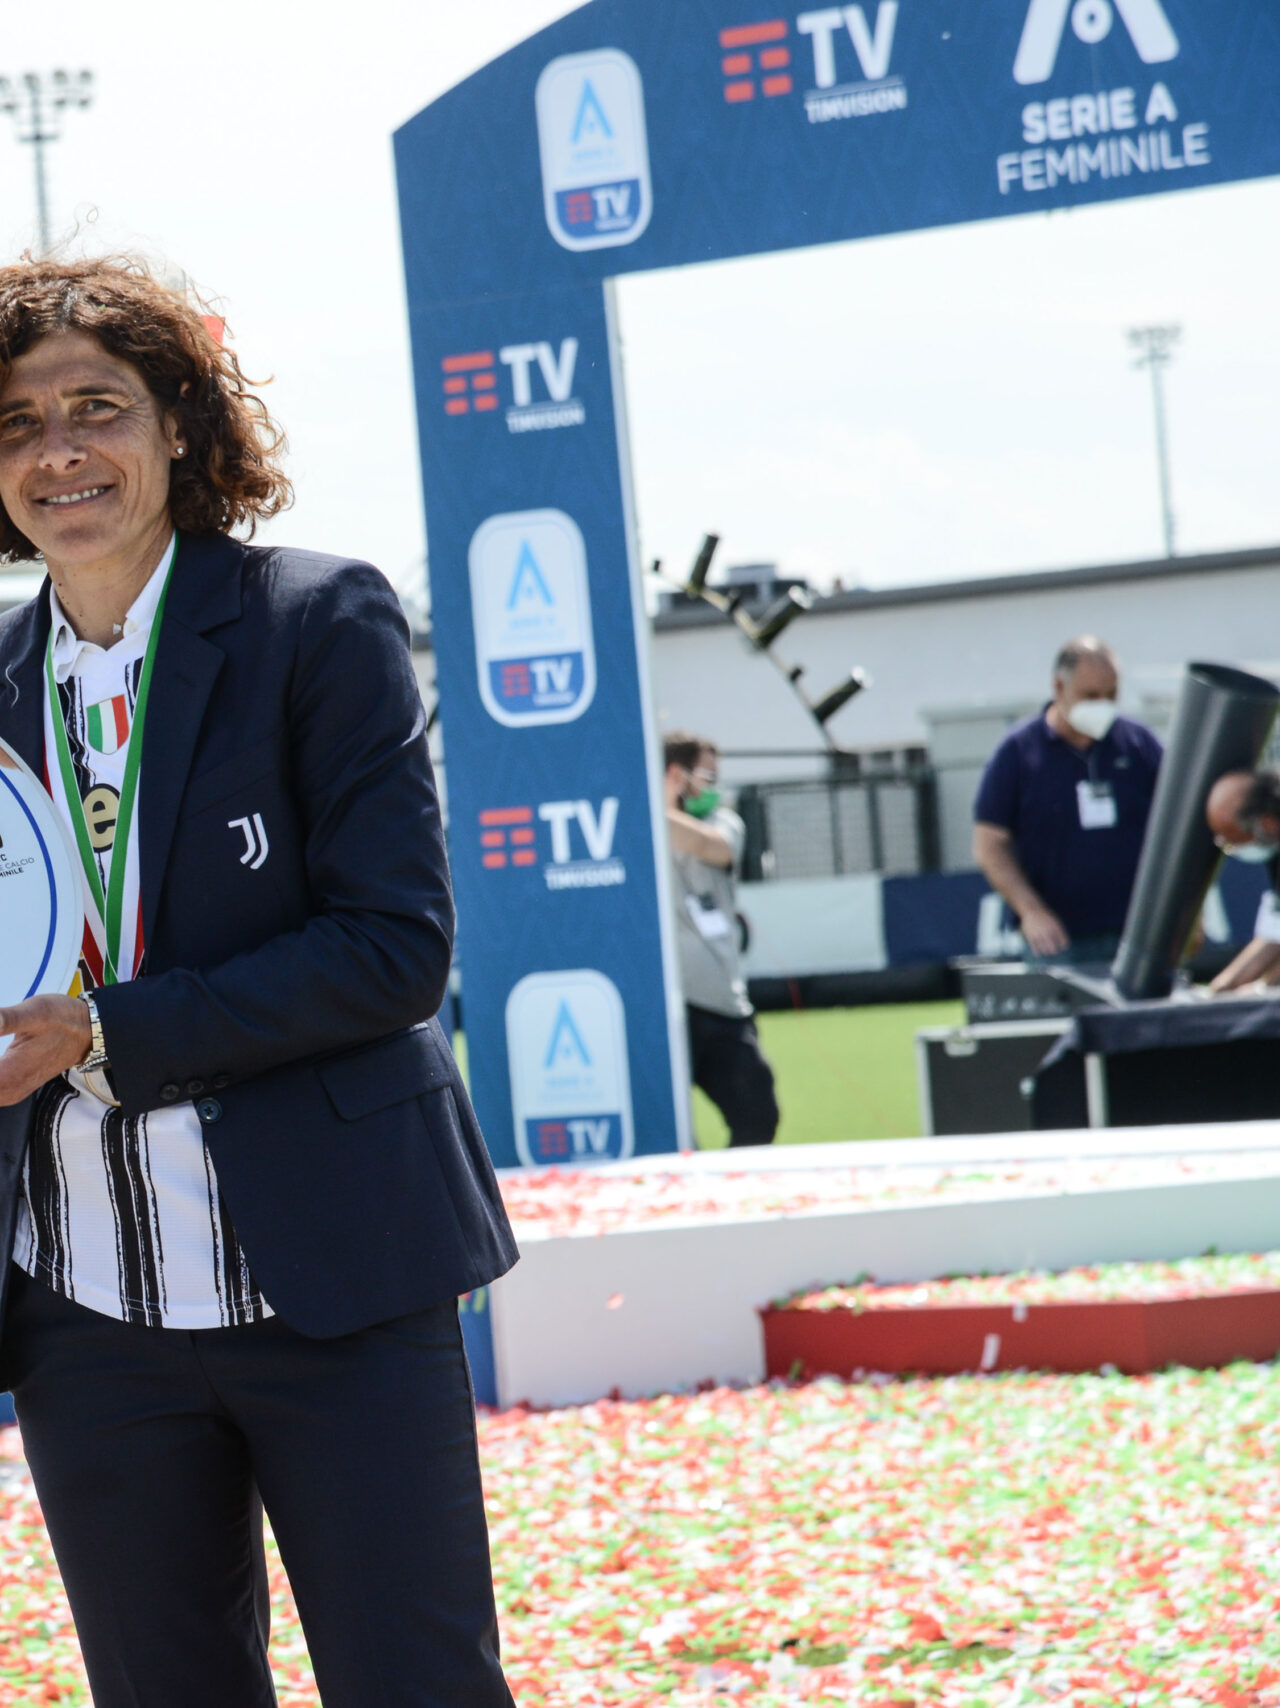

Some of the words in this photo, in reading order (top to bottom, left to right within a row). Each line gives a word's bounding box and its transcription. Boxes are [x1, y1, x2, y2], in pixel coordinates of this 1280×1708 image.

[796, 0, 899, 89] TV
[804, 84, 907, 124] TIMVISION
[1021, 86, 1137, 144] SERIE
[1144, 81, 1178, 125] A
[996, 122, 1211, 195] FEMMINILE
[592, 184, 631, 220] TV
[499, 337, 579, 407] TV
[530, 656, 572, 692] TV
[538, 797, 619, 864] TV
[4, 857, 35, 869] CALCIO
[567, 1120, 610, 1154] TV
